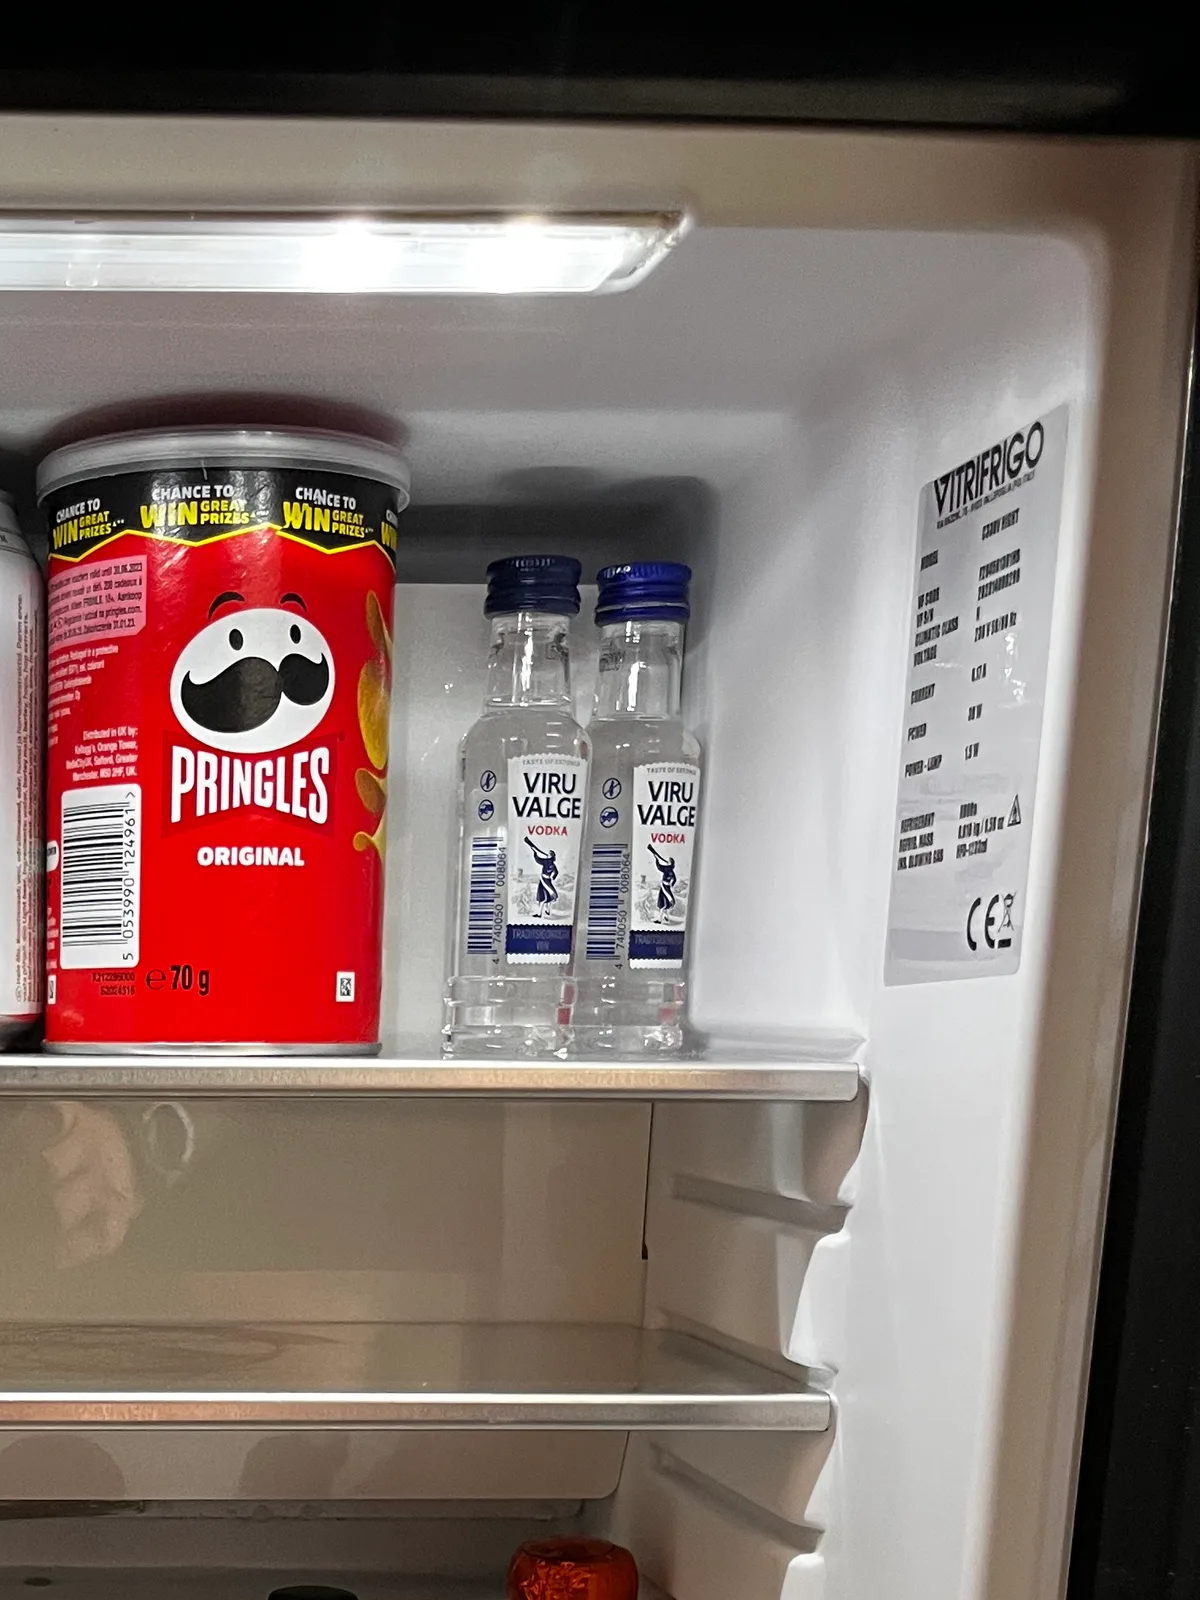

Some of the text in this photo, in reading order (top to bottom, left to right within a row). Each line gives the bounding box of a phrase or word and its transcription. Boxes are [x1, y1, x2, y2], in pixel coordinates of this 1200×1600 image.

[933, 421, 1045, 517] VITRIFRIGO
[151, 484, 234, 501] CHANCE TO
[295, 487, 356, 510] CHANCE TO
[56, 498, 101, 523] CHANCE TO
[140, 500, 247, 529] WIN GREAT
[200, 512, 250, 525] PRIZES
[282, 501, 330, 532] WIN
[332, 509, 364, 525] GREAT
[53, 511, 110, 549] WIN GREAT
[79, 523, 112, 541] PRIZES
[332, 523, 366, 538] PRIZES
[381, 521, 397, 551] WI
[170, 745, 330, 824] PRINGLES
[522, 772, 576, 794] VIRU
[648, 781, 694, 803] VIRU
[511, 796, 581, 819] VALGE
[637, 804, 695, 827] VALGE
[123, 808, 136, 867] 124961
[527, 825, 568, 836] VODKA
[651, 833, 686, 844] VODKA
[196, 846, 305, 867] ORIGINAL
[122, 877, 135, 939] 053990
[170, 964, 194, 991] 70
[198, 969, 210, 996] g
